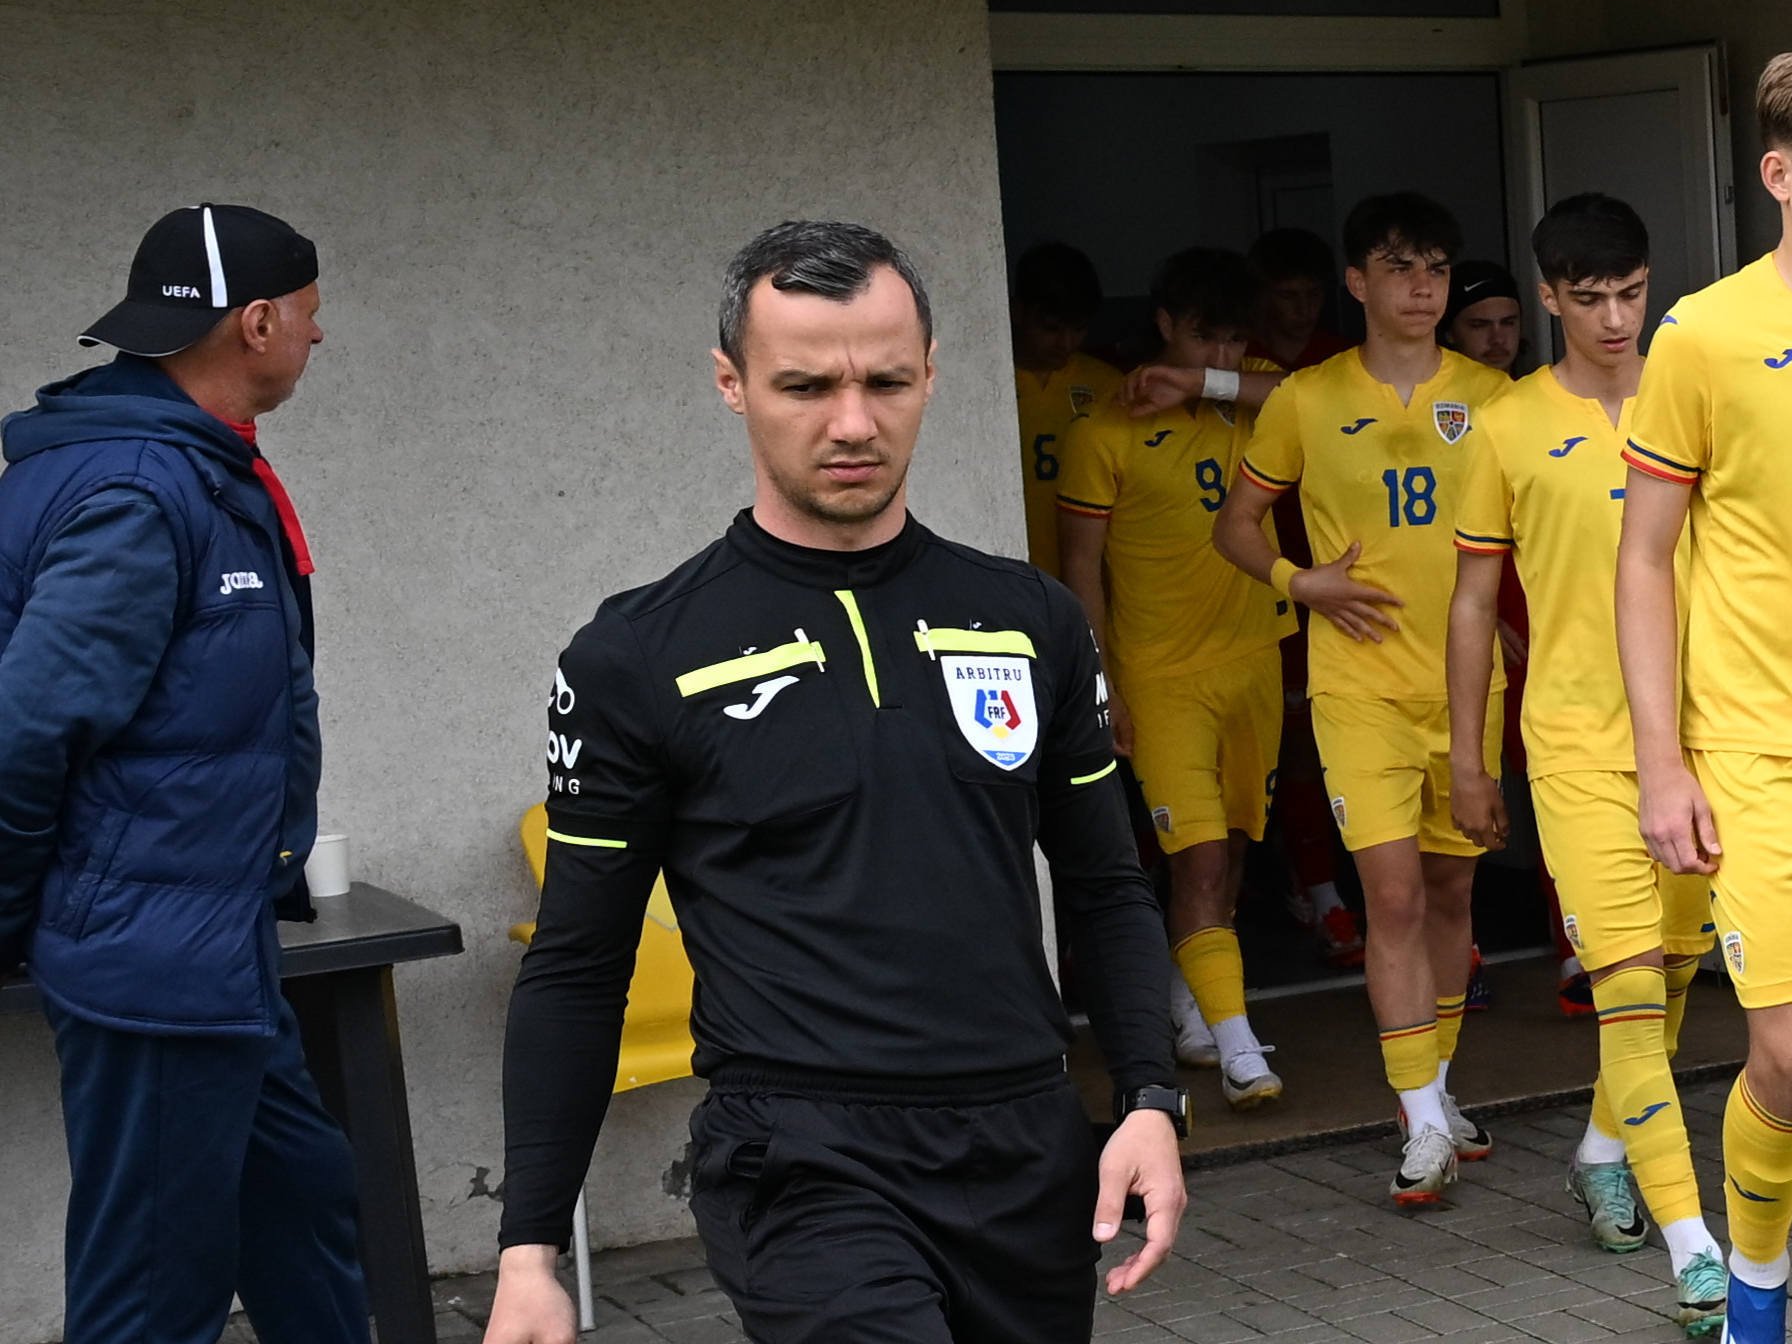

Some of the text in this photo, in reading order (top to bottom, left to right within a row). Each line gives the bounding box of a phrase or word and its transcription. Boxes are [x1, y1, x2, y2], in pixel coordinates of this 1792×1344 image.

[162, 284, 201, 299] UEFA
[1195, 458, 1227, 512] 9
[1382, 466, 1437, 528] 18
[956, 667, 1023, 681] ARBITRU
[987, 706, 1007, 720] FRF
